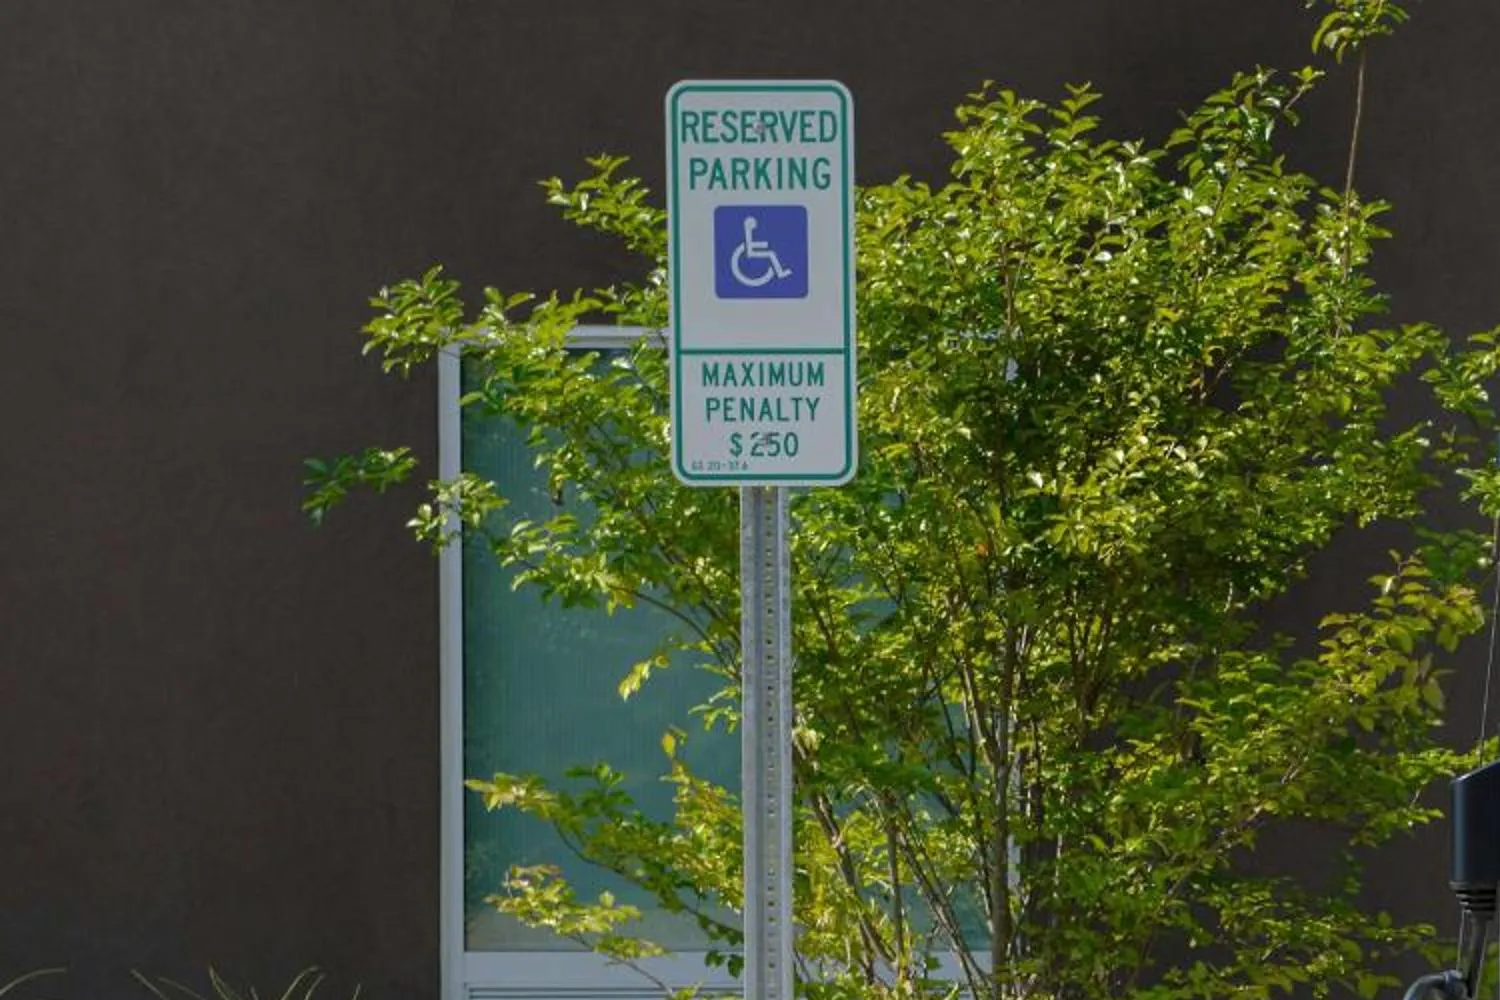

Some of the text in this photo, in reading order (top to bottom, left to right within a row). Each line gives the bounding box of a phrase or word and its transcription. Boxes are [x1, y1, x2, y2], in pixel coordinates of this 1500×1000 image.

[681, 111, 838, 144] RESERVED
[689, 157, 831, 191] PARKING
[701, 361, 825, 387] MAXIMUM
[705, 396, 821, 422] PENALTY
